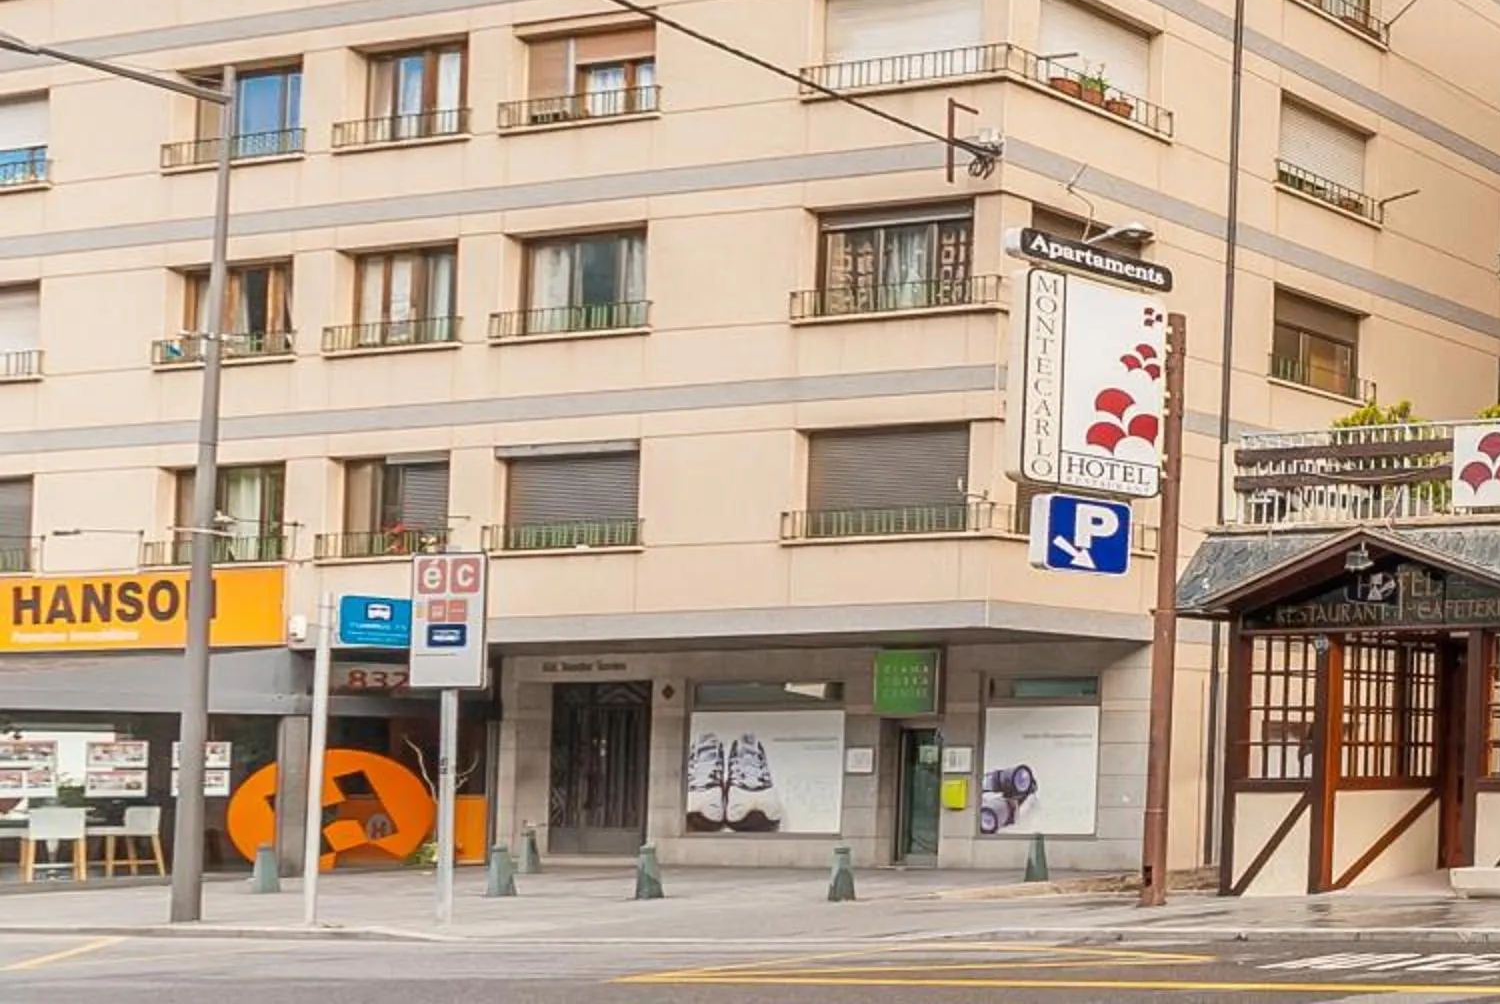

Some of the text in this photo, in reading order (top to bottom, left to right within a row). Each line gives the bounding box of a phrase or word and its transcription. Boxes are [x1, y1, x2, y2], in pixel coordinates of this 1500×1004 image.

[1030, 234, 1165, 285] Apartaments
[1031, 275, 1057, 477] MONTECARLO
[1067, 456, 1150, 485] HOTEL
[1074, 503, 1119, 549] P
